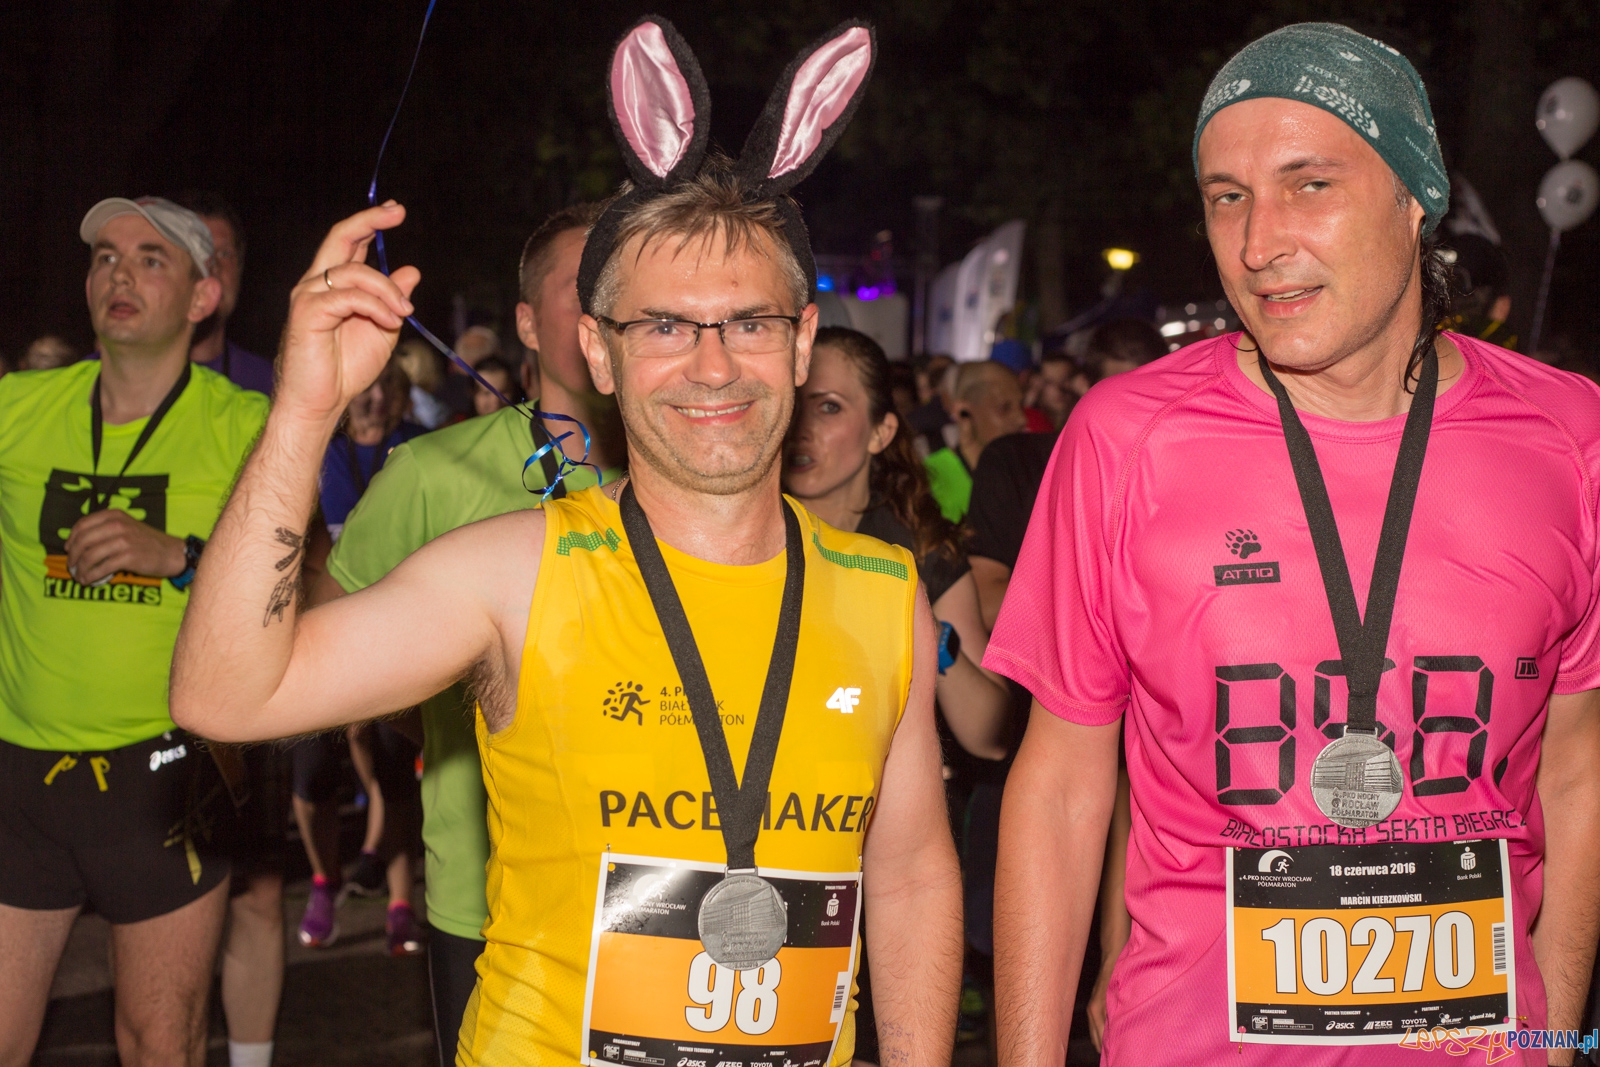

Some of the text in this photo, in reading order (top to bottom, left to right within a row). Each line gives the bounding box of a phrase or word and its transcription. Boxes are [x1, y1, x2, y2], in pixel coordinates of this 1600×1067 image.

[1222, 567, 1275, 580] ATTIQ
[44, 577, 161, 605] runners
[826, 687, 861, 714] 4F
[1376, 816, 1447, 843] SEKTA
[1329, 862, 1416, 876] 18 czerwca 2016
[1340, 893, 1422, 905] MARCIN KIERZKOWSKI
[1261, 910, 1476, 996] 10270
[684, 950, 782, 1035] 98
